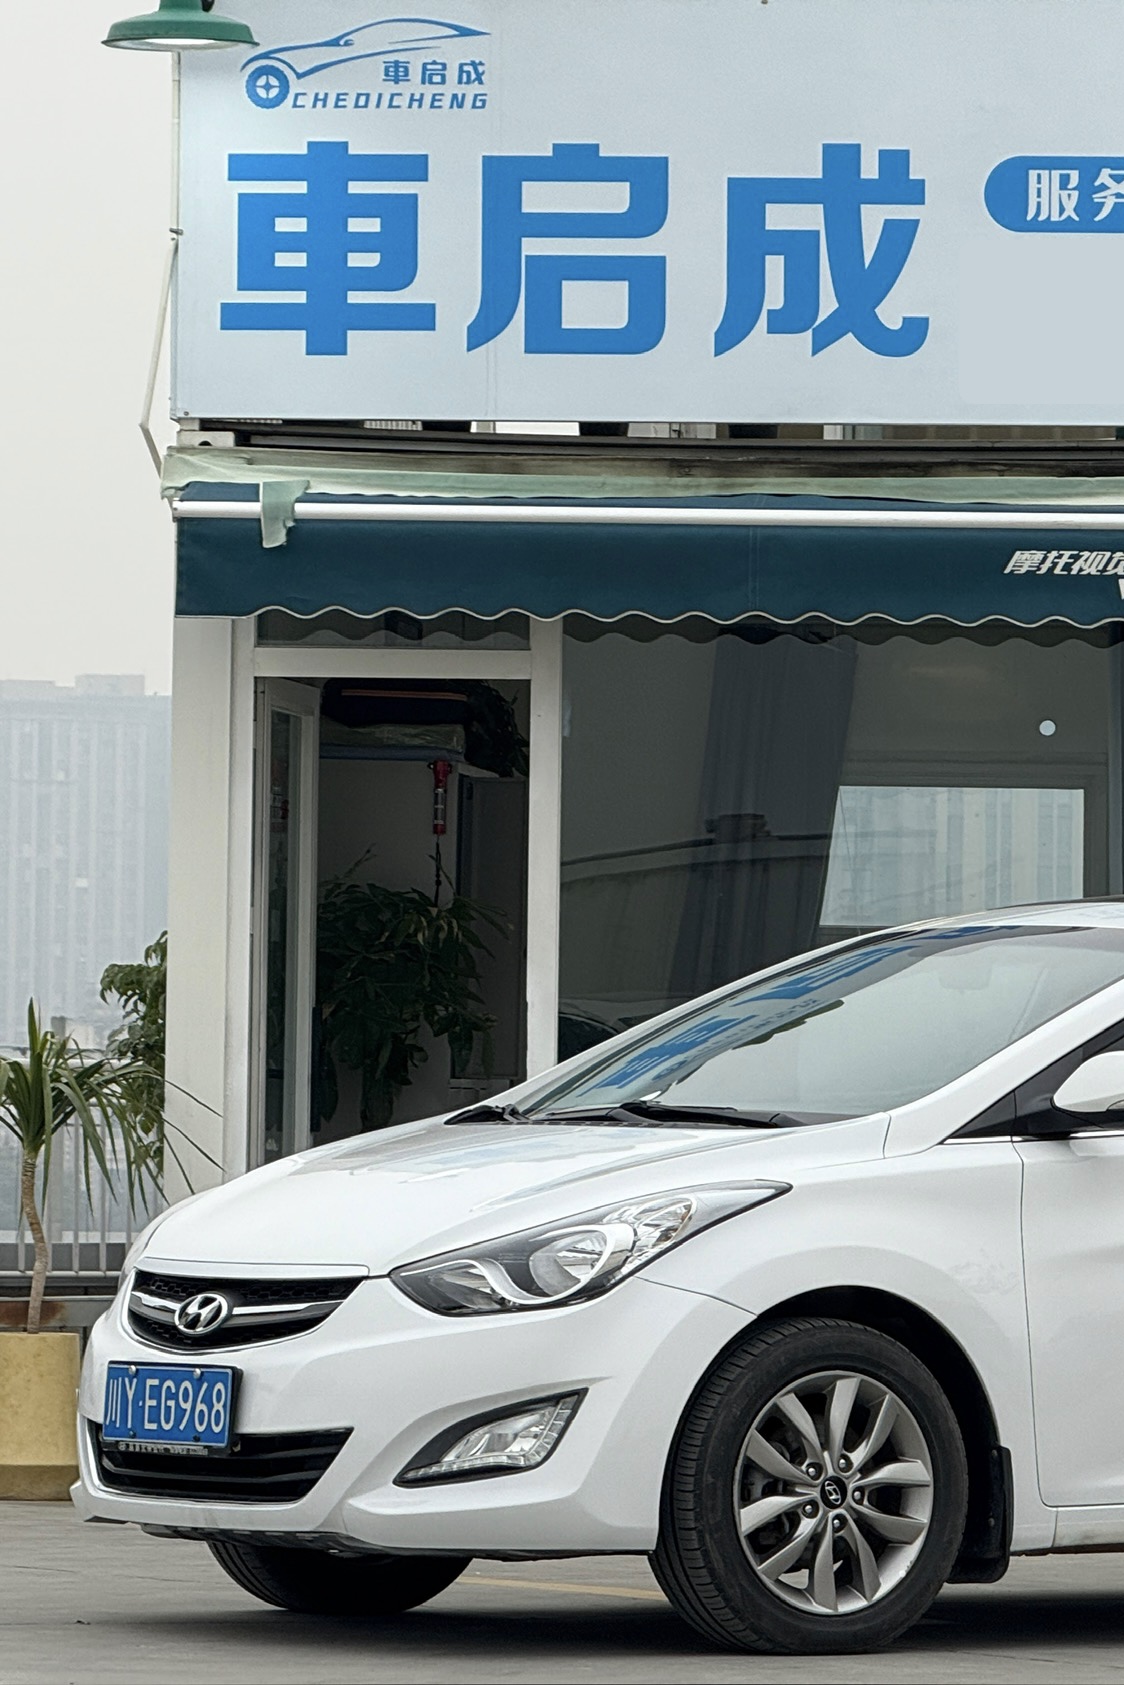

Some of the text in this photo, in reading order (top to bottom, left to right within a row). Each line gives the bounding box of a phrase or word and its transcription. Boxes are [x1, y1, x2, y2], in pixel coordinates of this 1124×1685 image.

[382, 59, 486, 86] 車启成
[219, 140, 930, 359] 車启成
